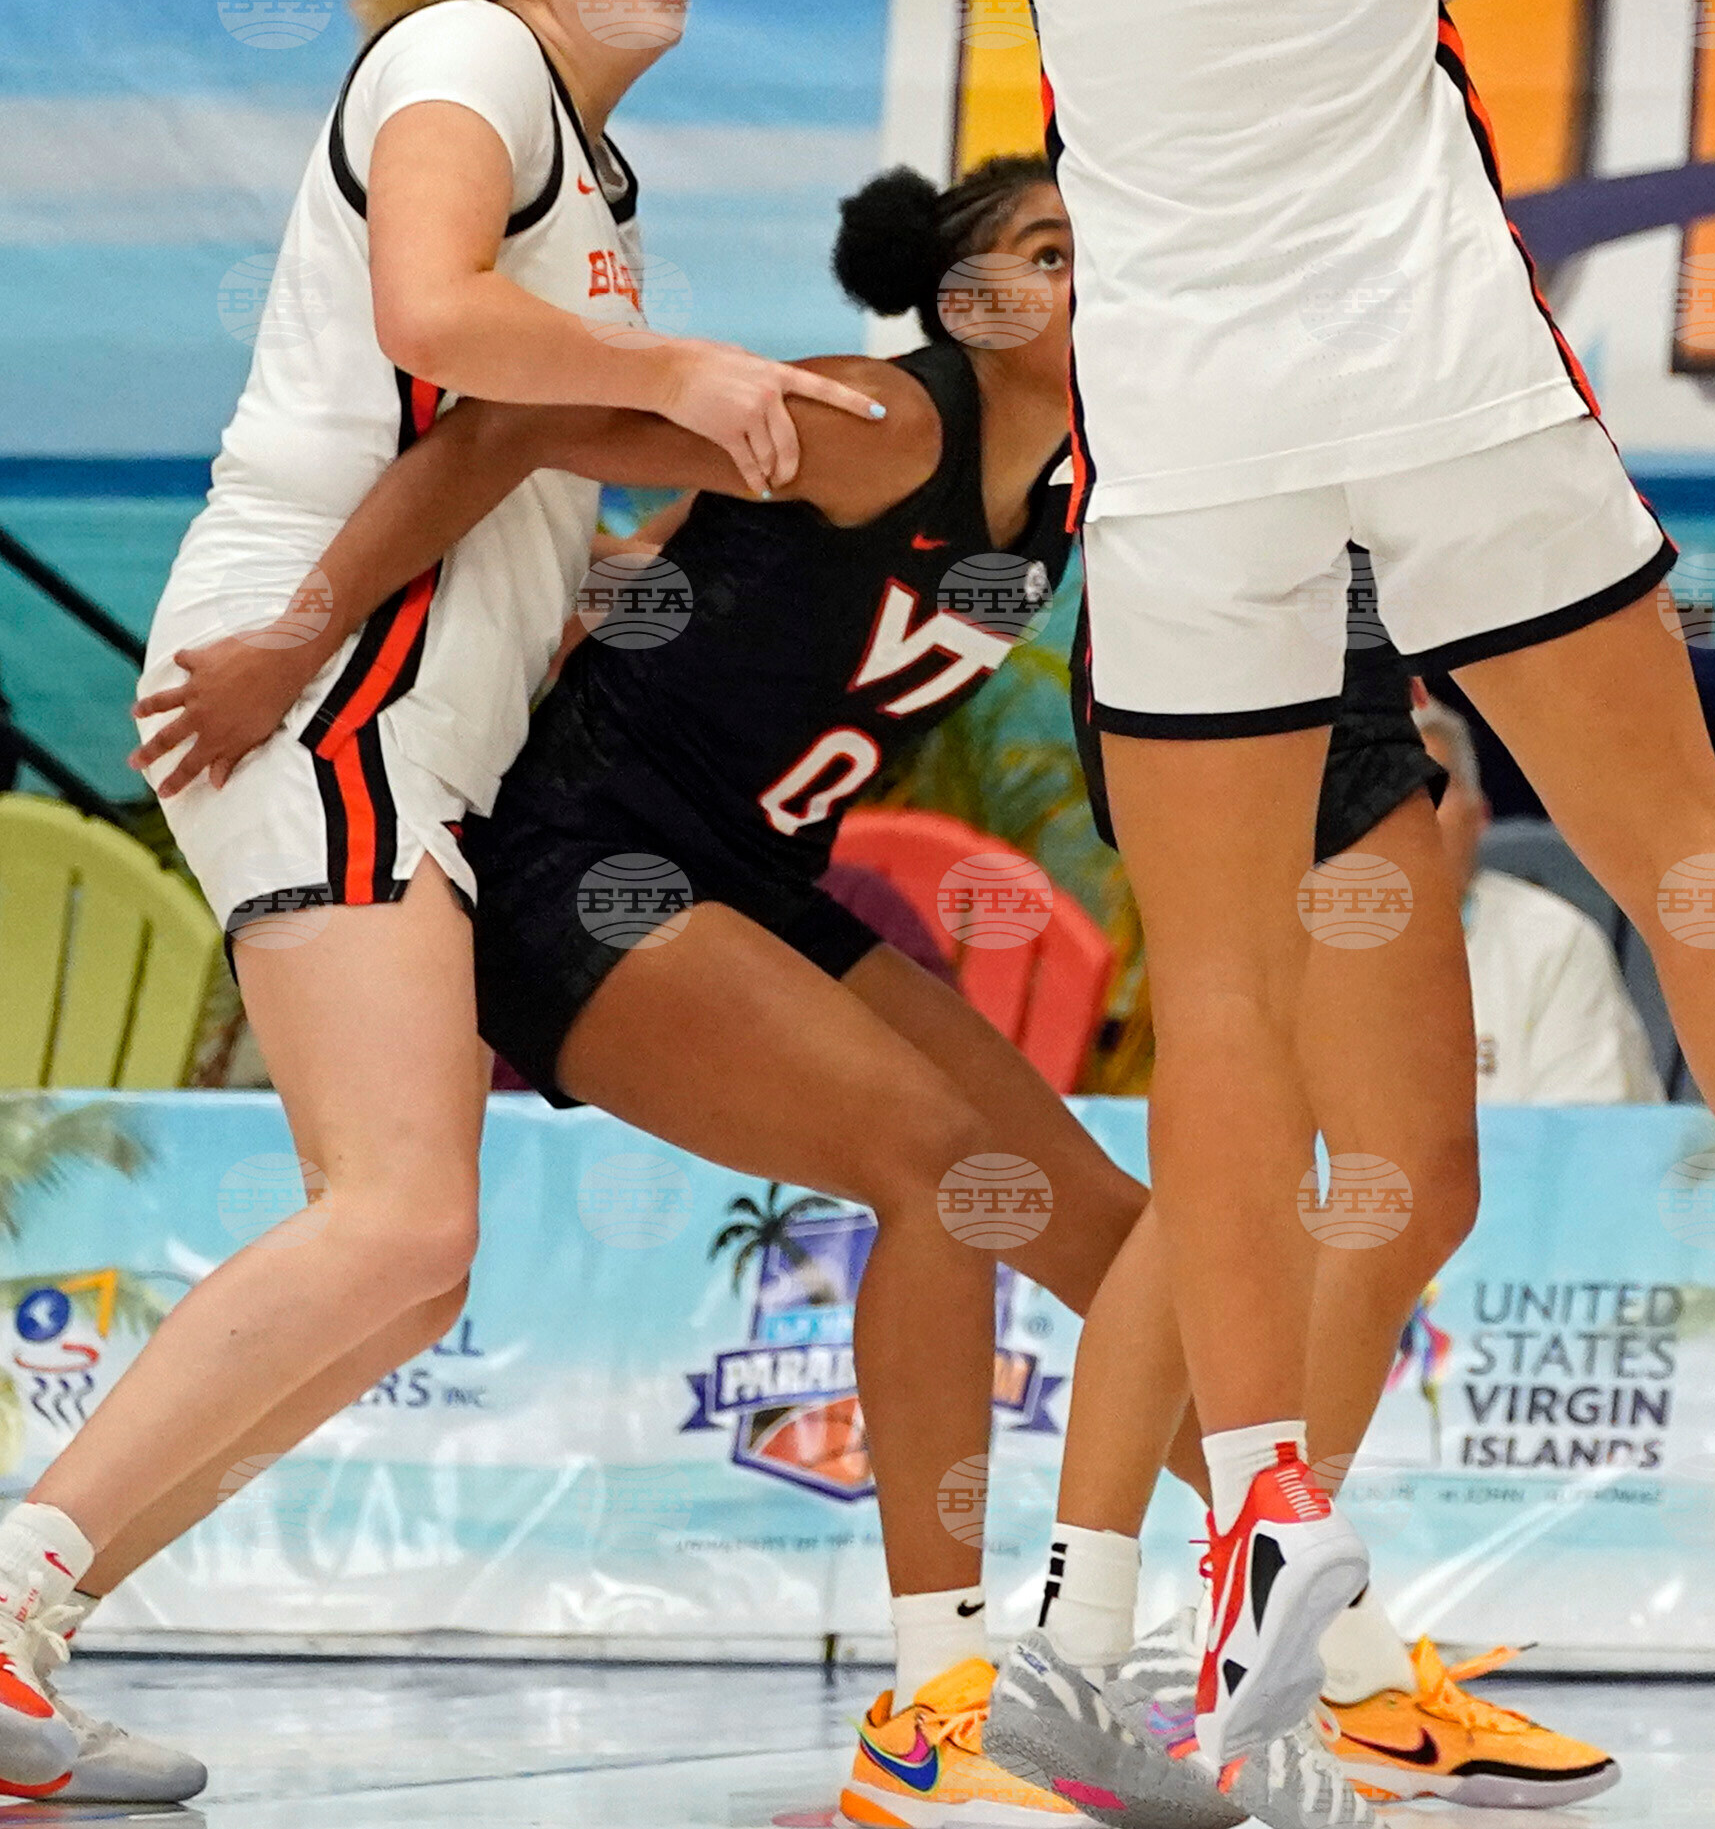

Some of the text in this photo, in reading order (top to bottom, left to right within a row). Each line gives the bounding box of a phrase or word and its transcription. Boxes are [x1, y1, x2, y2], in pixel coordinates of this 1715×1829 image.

[846, 575, 1016, 719] VT
[757, 725, 881, 837] 0
[1473, 1281, 1683, 1326] UNITED
[1467, 1330, 1676, 1380] STATES
[1463, 1384, 1671, 1427] VIRGIN
